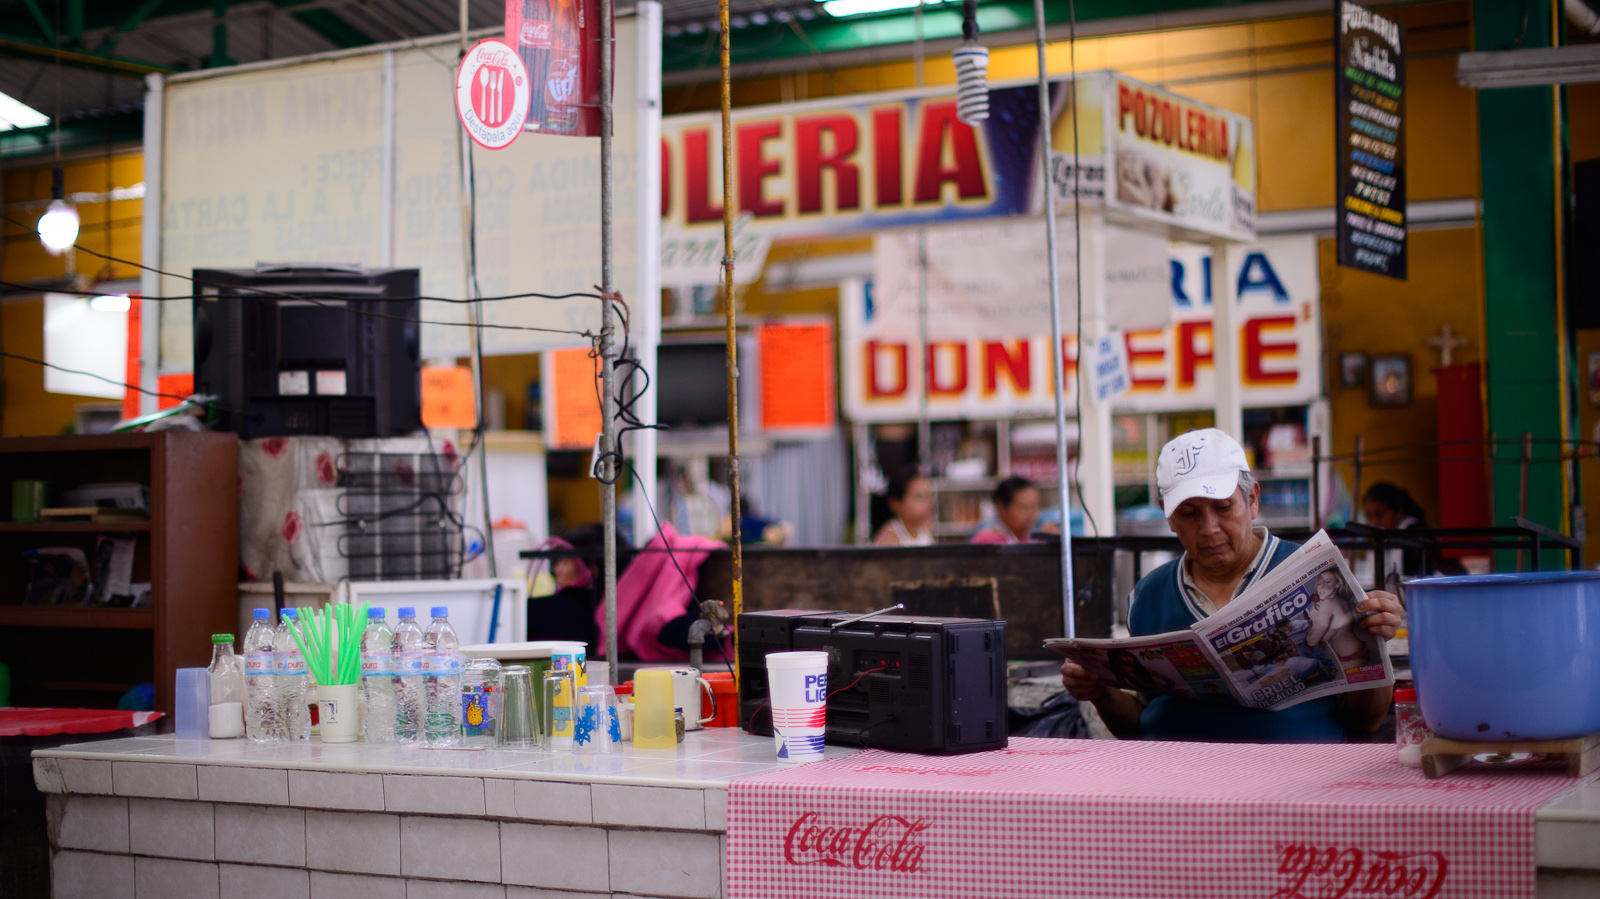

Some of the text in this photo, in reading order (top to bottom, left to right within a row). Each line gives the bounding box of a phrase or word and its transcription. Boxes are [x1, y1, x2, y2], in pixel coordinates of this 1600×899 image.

[1340, 0, 1401, 56] POZOLERIA
[477, 47, 510, 66] Coca-Cola
[464, 108, 506, 144] Destápala
[1117, 82, 1228, 163] POZOLERIA
[660, 99, 993, 226] LERIA
[1215, 637, 1228, 649] El
[804, 673, 828, 688] PE
[1251, 672, 1302, 703] CRUEL
[1256, 682, 1307, 709] DESALOJO
[784, 811, 935, 874] Coca-Cola
